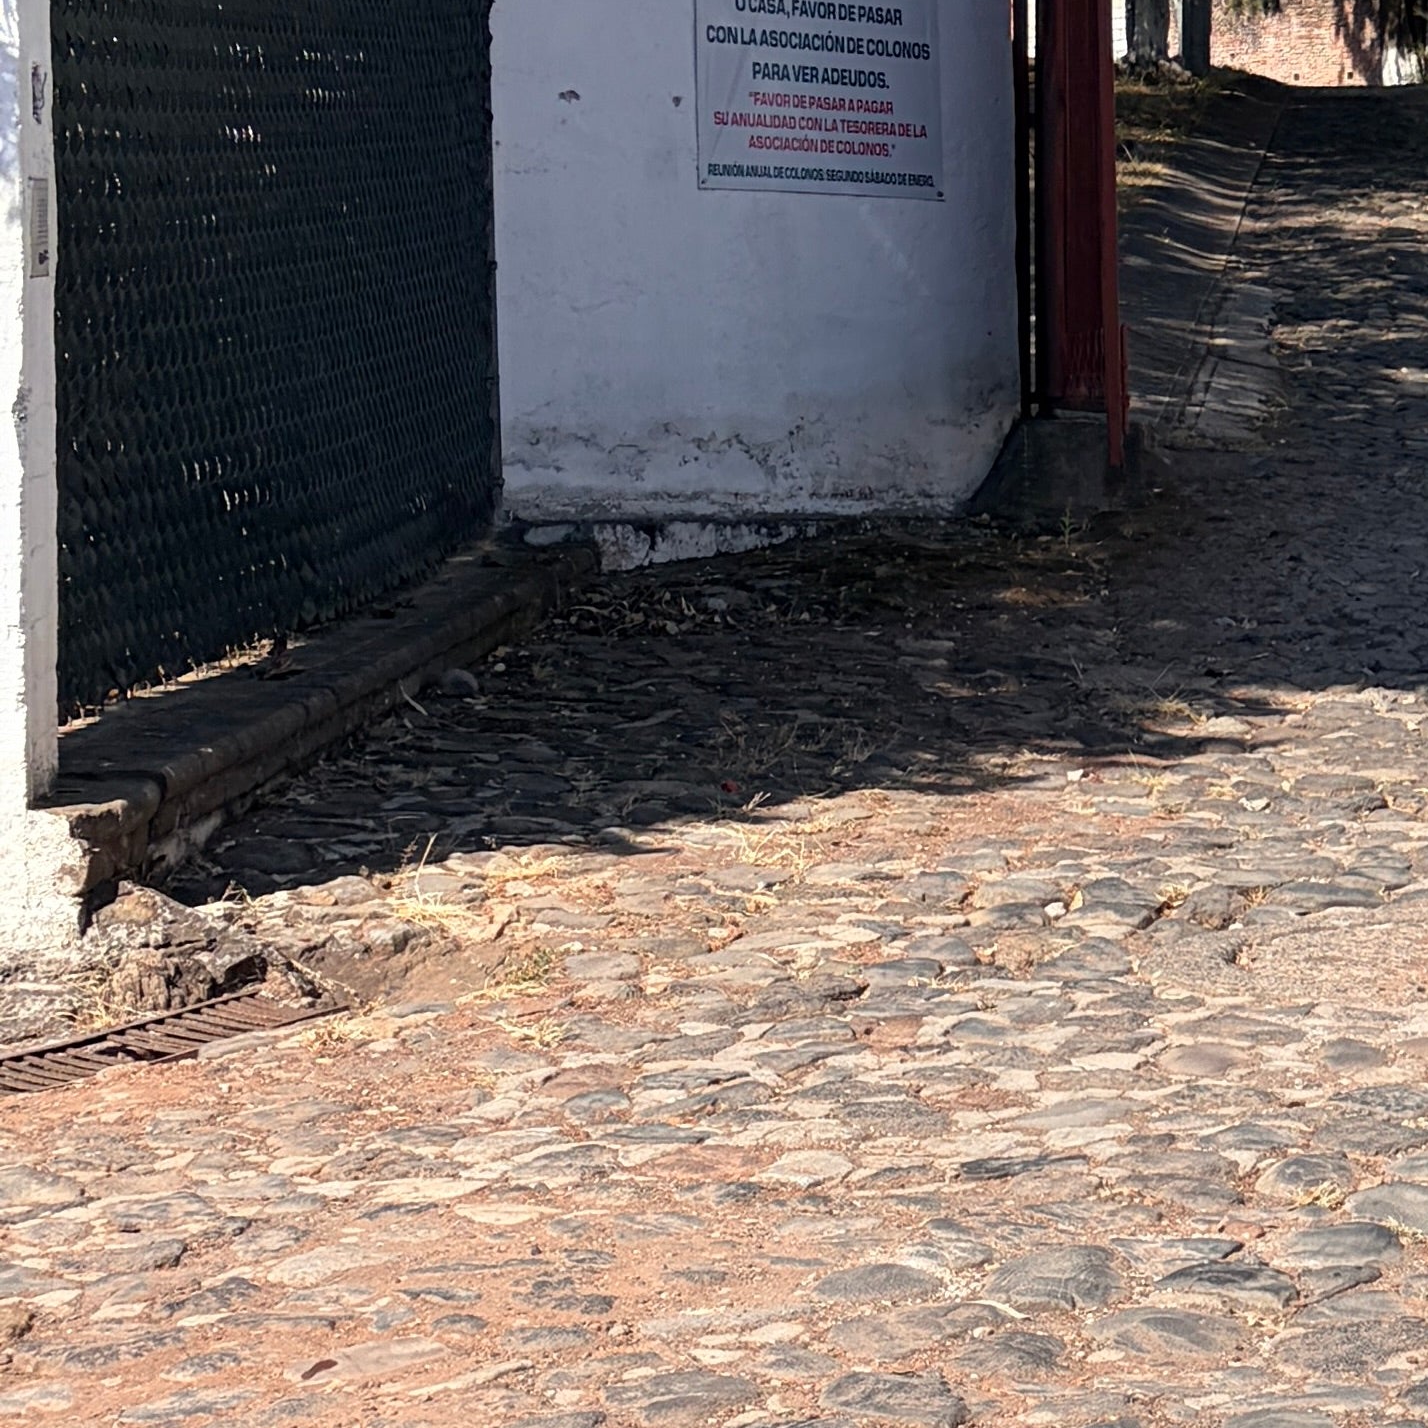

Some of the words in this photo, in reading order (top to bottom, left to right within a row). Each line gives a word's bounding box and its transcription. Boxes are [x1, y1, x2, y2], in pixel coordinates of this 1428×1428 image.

[838, 3, 856, 22] DE
[858, 5, 903, 26] PASAR
[706, 25, 738, 45] CON
[740, 27, 758, 46] LA
[760, 29, 845, 54] ASOCIACIÓN
[846, 37, 864, 55] DE
[866, 39, 931, 60] COLONOS
[752, 62, 791, 82] PARA
[791, 65, 819, 84] VER
[821, 68, 890, 89] ADEUDOS.
[792, 96, 807, 109] DE
[808, 97, 846, 112] PASAR
[847, 99, 856, 111] A
[856, 99, 894, 116] PAGAR
[714, 111, 729, 126] SU
[731, 112, 797, 130] ANUALIDAD
[799, 117, 823, 131] CON
[824, 118, 839, 133] LA
[839, 119, 898, 137] TESORERA
[898, 123, 913, 138] DE
[913, 125, 928, 139] LA
[748, 134, 819, 153] ASOCIACIÓN
[820, 139, 835, 154] DE
